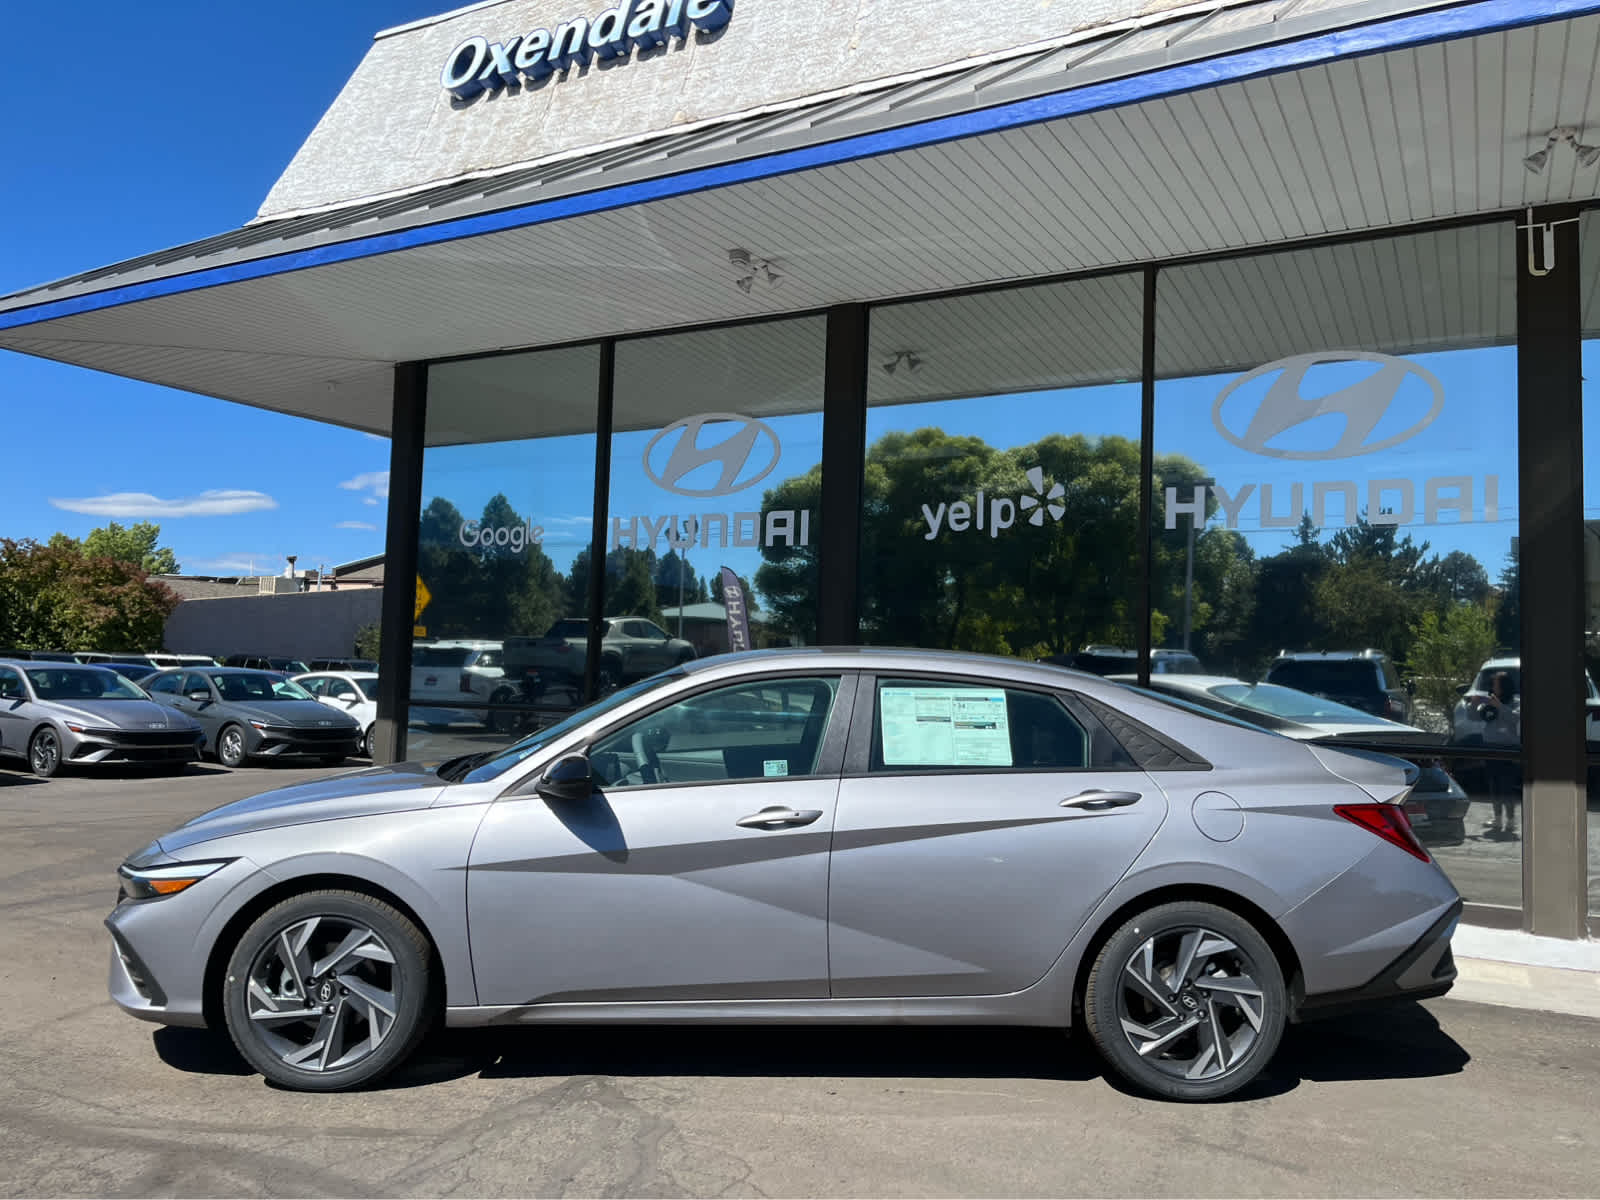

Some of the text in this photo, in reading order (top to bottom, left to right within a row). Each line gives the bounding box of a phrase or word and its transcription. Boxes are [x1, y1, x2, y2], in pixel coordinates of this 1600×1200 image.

[921, 490, 1016, 541] yelp
[1164, 474, 1499, 530] HYUNDAI
[459, 516, 544, 553] Google
[611, 509, 810, 550] HYUNDAI
